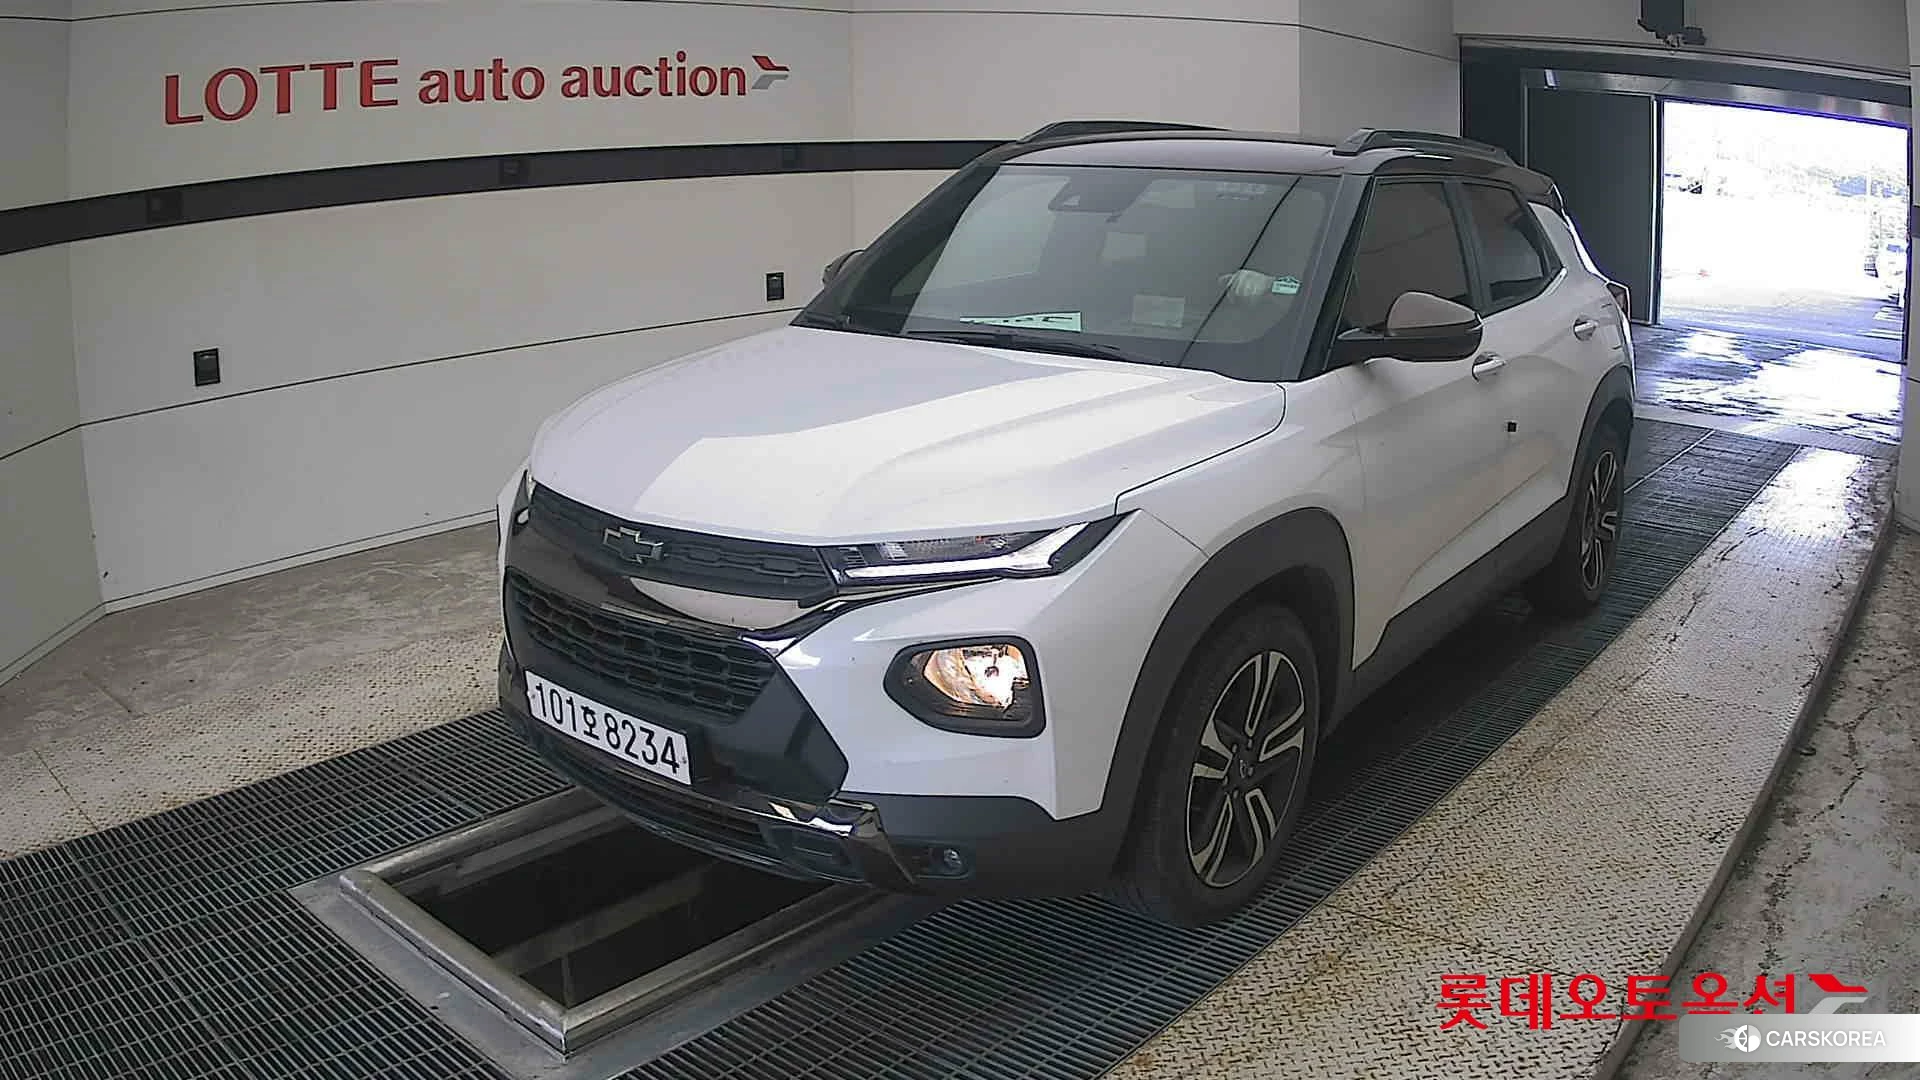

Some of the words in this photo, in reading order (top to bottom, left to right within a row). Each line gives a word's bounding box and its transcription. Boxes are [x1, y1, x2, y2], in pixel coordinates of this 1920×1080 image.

[164, 59, 399, 124] LOTTE
[418, 58, 545, 103] auto
[561, 51, 746, 97] auction
